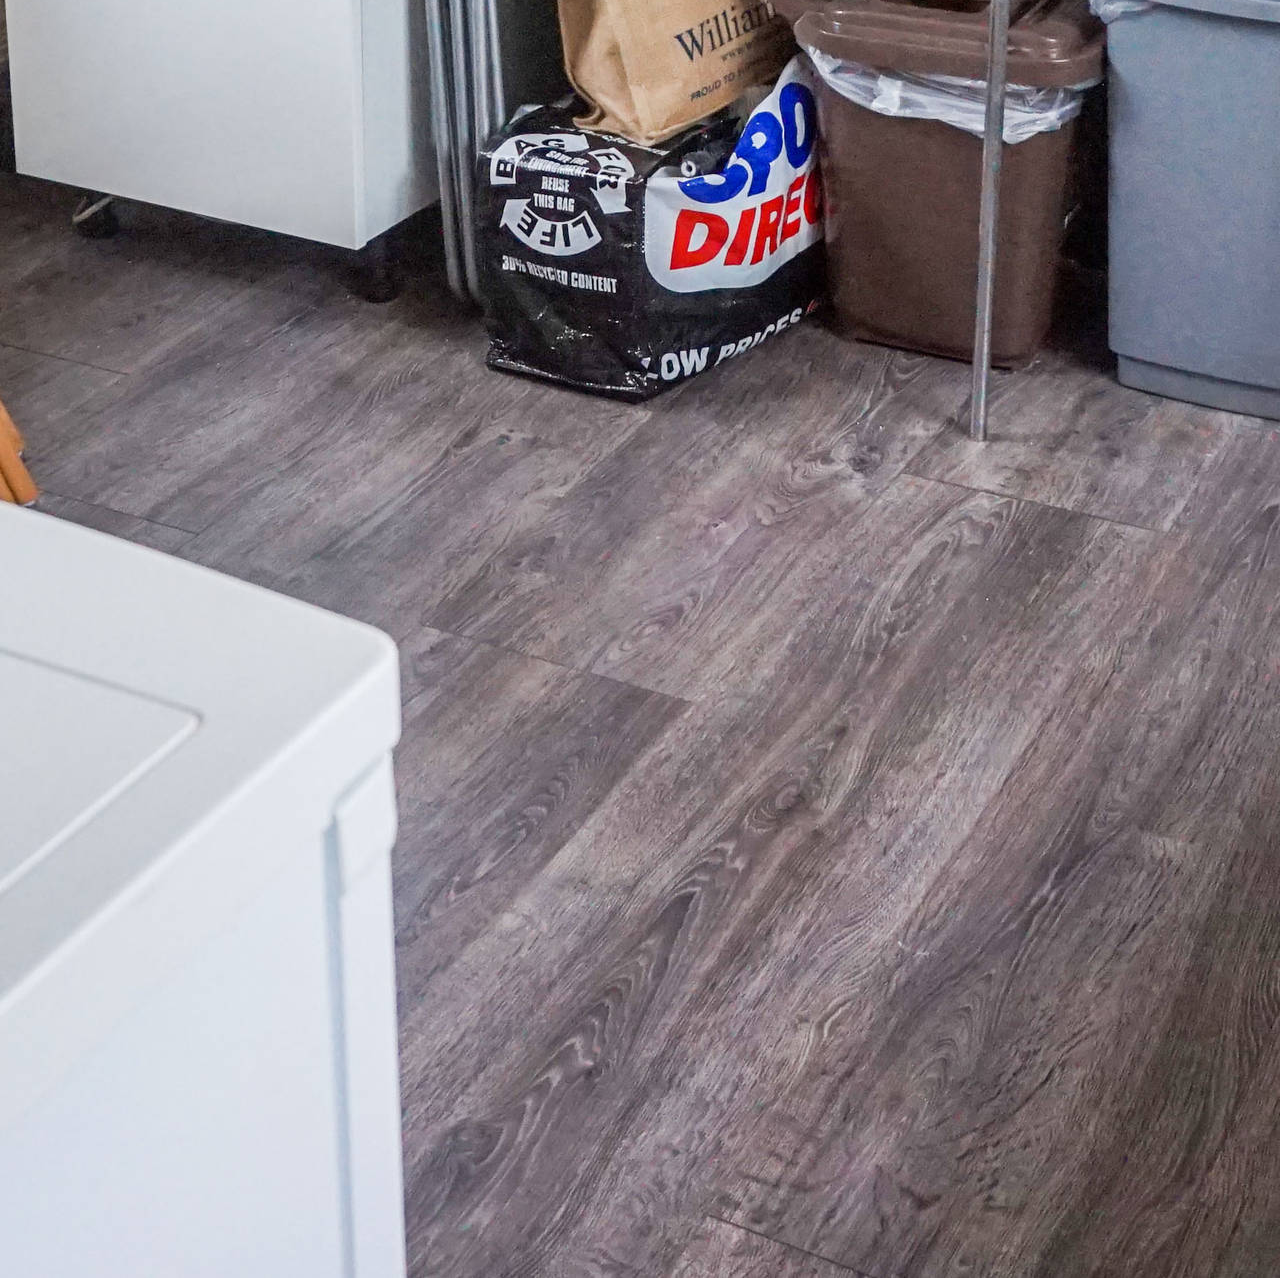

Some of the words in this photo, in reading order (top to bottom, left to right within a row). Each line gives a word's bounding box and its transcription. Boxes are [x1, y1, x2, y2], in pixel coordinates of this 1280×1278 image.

[690, 80, 722, 102] PROUD
[495, 138, 566, 179] BAG
[594, 152, 627, 190] FOR
[541, 176, 570, 193] REUSE
[533, 193, 555, 209] THIS
[556, 196, 575, 213] BAG
[516, 208, 594, 248] LIFE
[502, 254, 527, 273] 30%
[526, 261, 568, 286] RECYCLED
[570, 271, 618, 294] CONTENT
[641, 346, 710, 381] LOW
